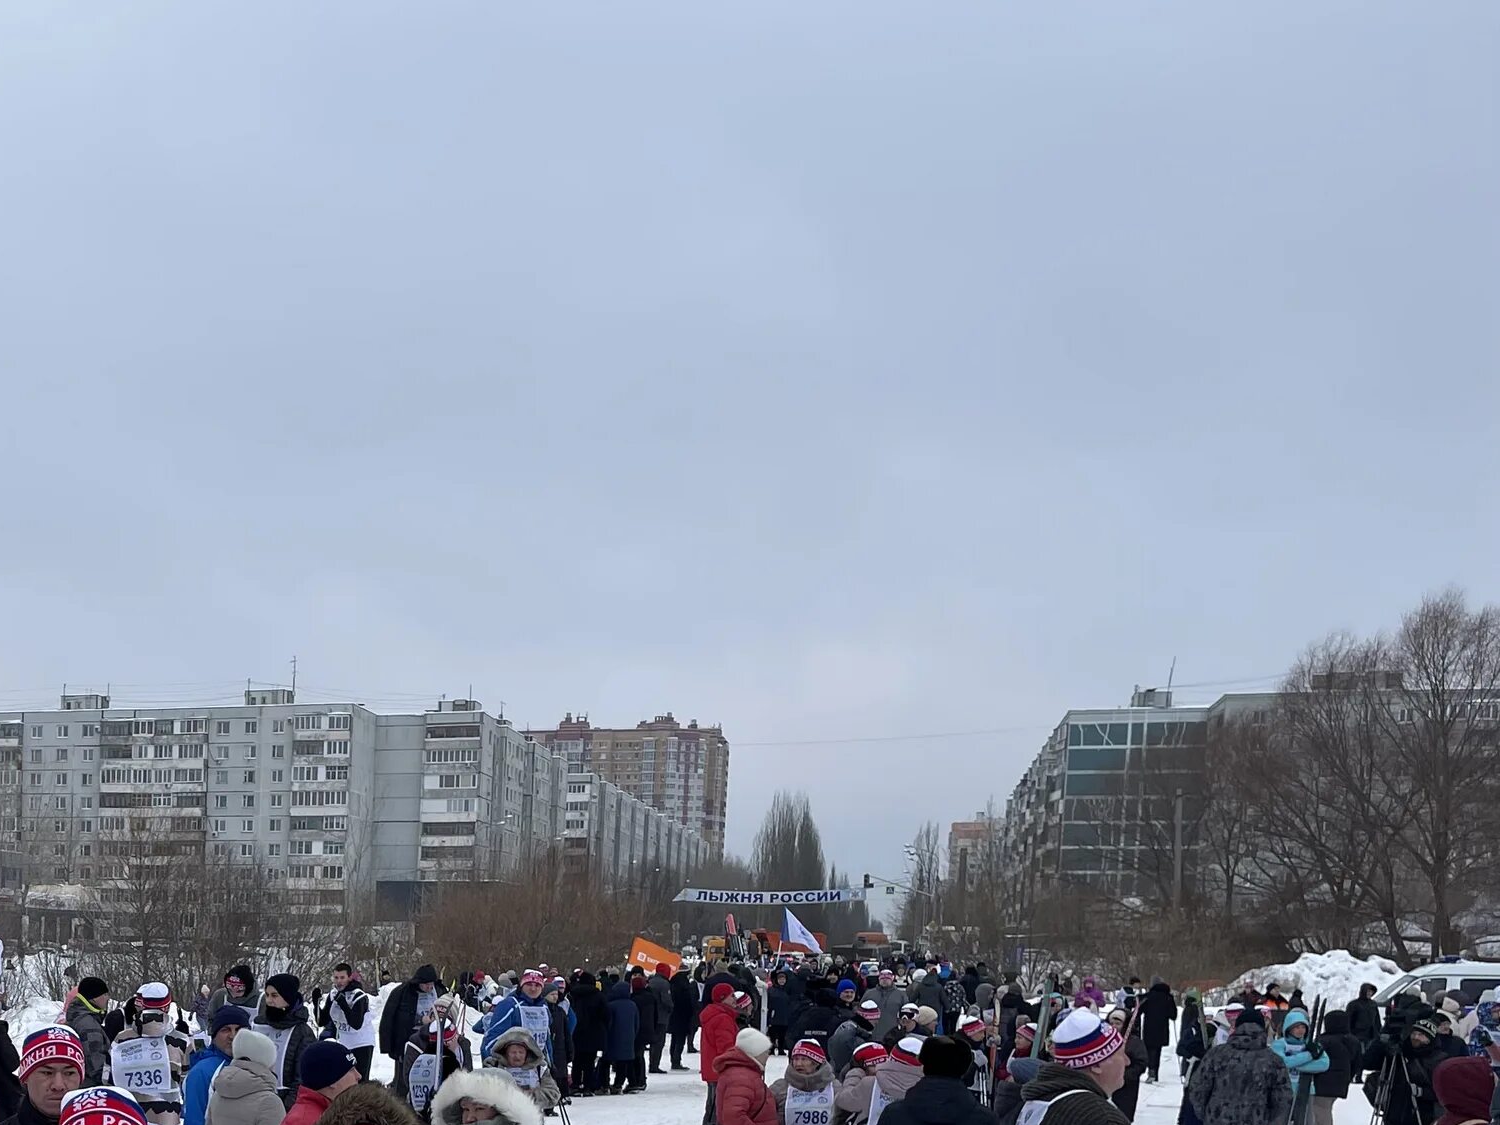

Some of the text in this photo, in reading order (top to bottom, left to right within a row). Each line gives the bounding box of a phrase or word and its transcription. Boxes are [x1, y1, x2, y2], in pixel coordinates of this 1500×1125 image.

[696, 890, 841, 904] ЛЫЖНЯ РОССИИ
[124, 1069, 163, 1087] 7336
[794, 1110, 828, 1125] 7986
